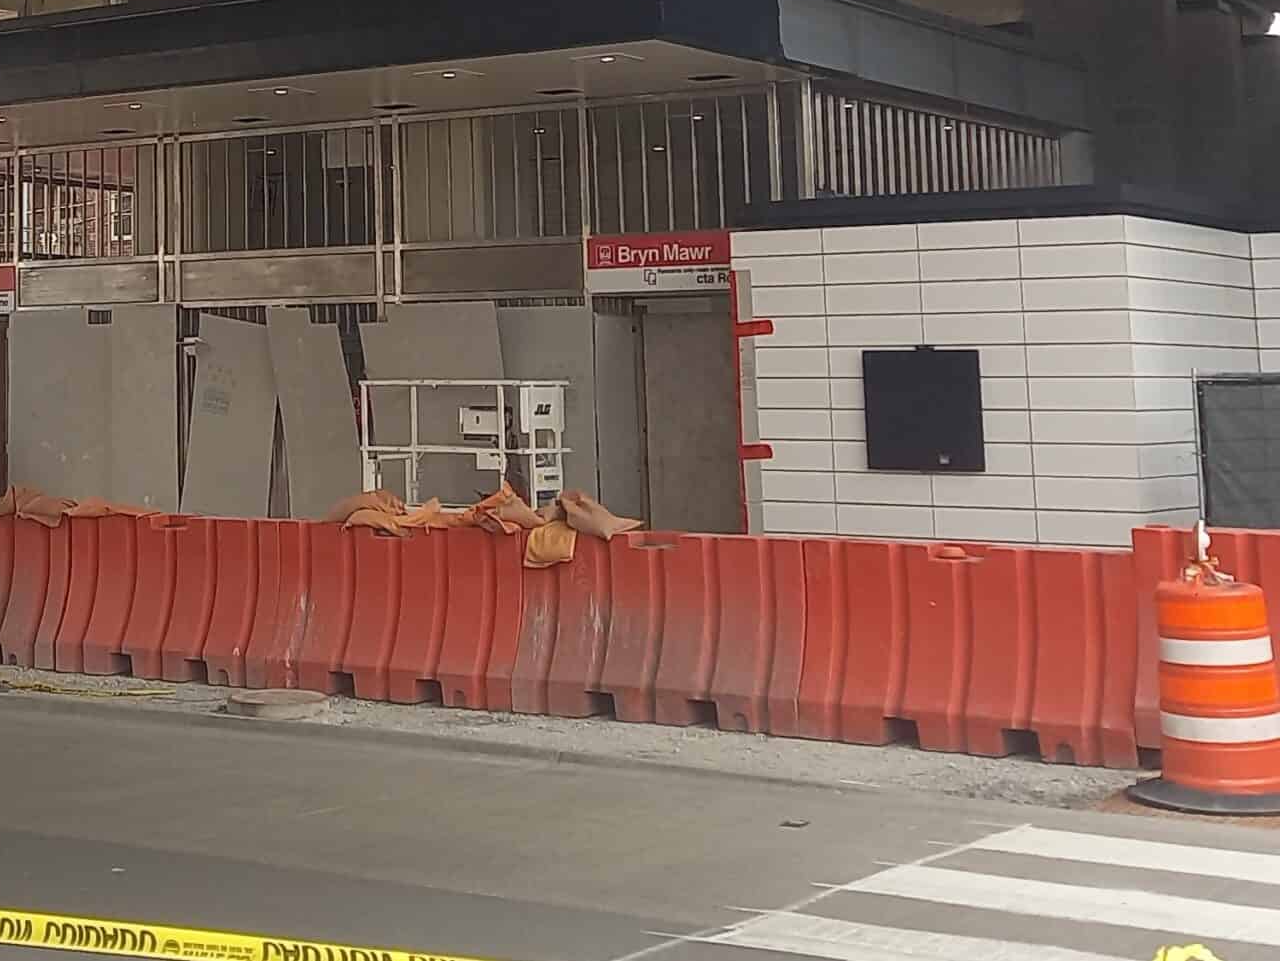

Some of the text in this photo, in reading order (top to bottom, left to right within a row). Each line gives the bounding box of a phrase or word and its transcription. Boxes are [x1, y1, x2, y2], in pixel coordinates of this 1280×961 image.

[618, 243, 712, 266] Bryn Mawr
[696, 274, 715, 284] cta
[534, 404, 552, 415] JLG
